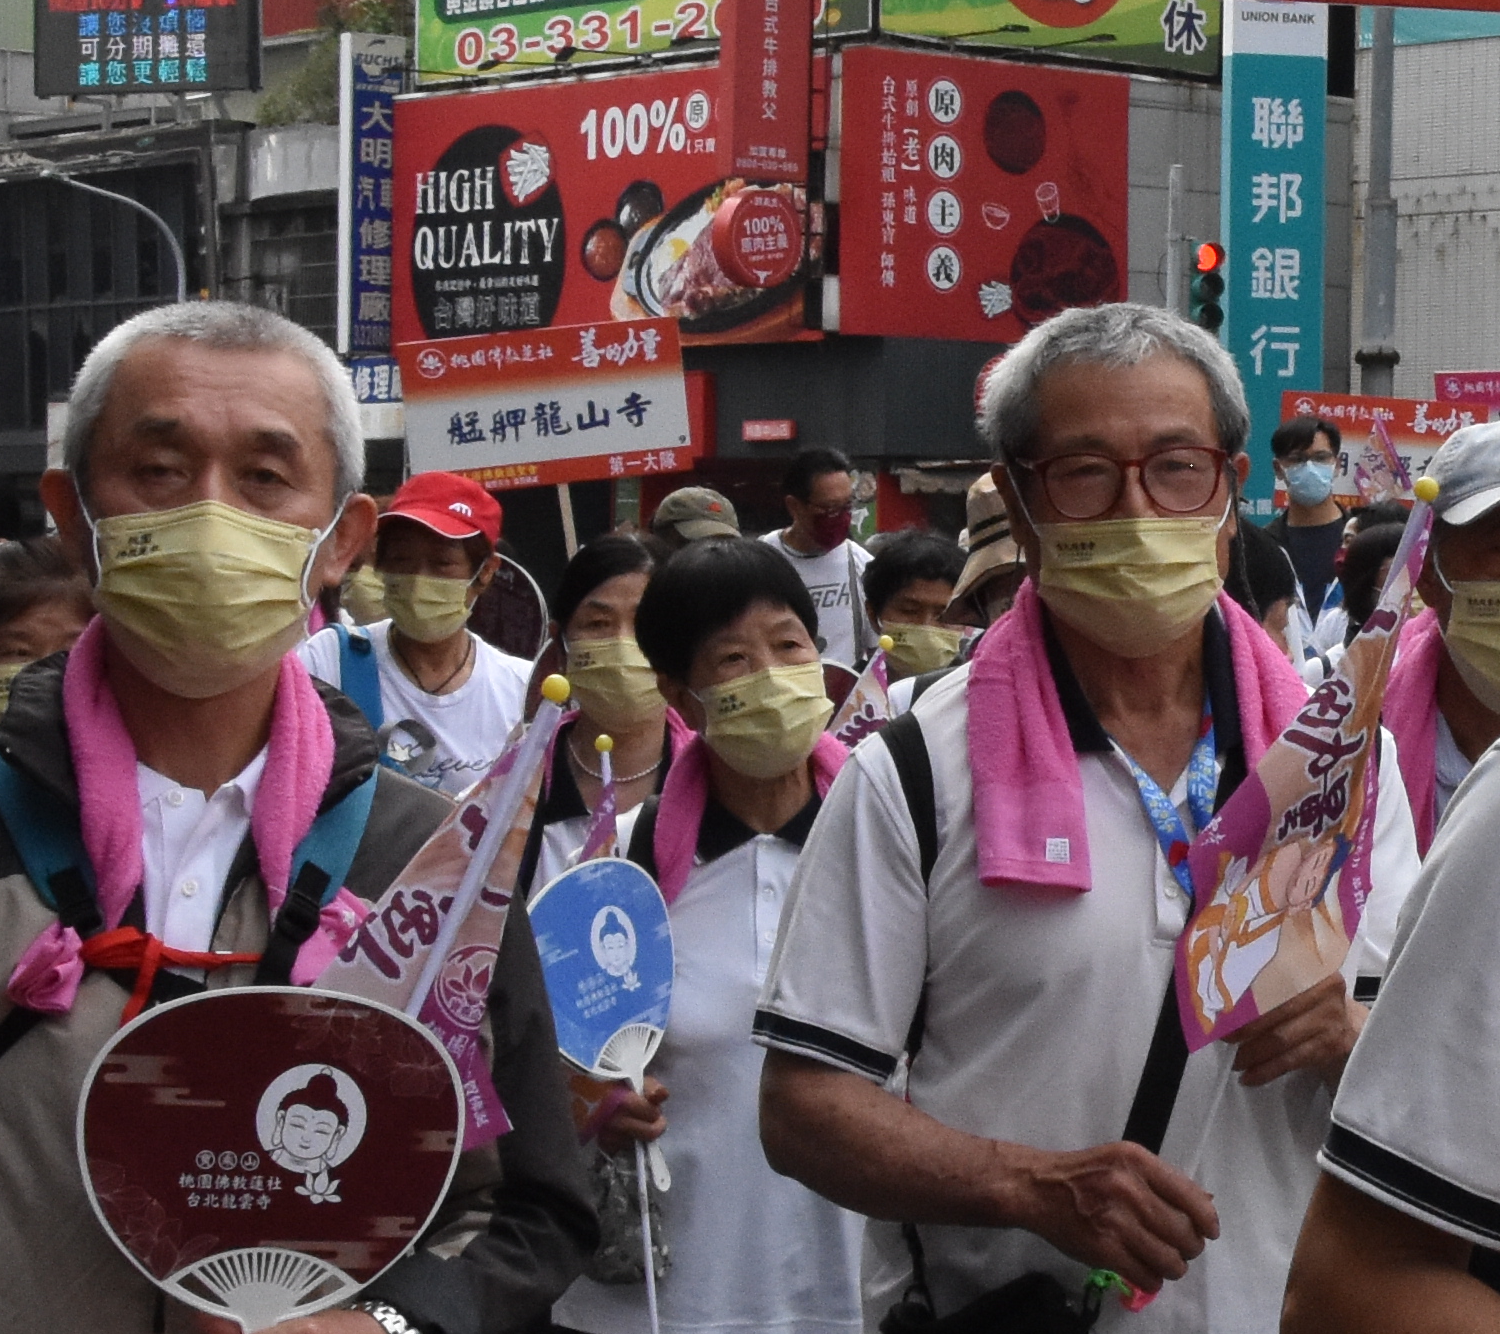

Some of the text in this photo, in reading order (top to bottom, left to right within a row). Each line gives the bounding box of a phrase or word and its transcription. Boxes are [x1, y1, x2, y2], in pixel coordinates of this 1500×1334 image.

[1241, 10, 1316, 26] UNION BANK
[579, 97, 687, 161] 100%
[415, 165, 495, 216] HIGH
[930, 83, 959, 288] 原肉主義
[414, 217, 560, 271] QUALITY
[743, 215, 785, 235] 100%
[1250, 95, 1305, 378] 聯邦銀行
[446, 391, 653, 446] 艋舺龍山寺
[608, 450, 678, 476] 第一大隊
